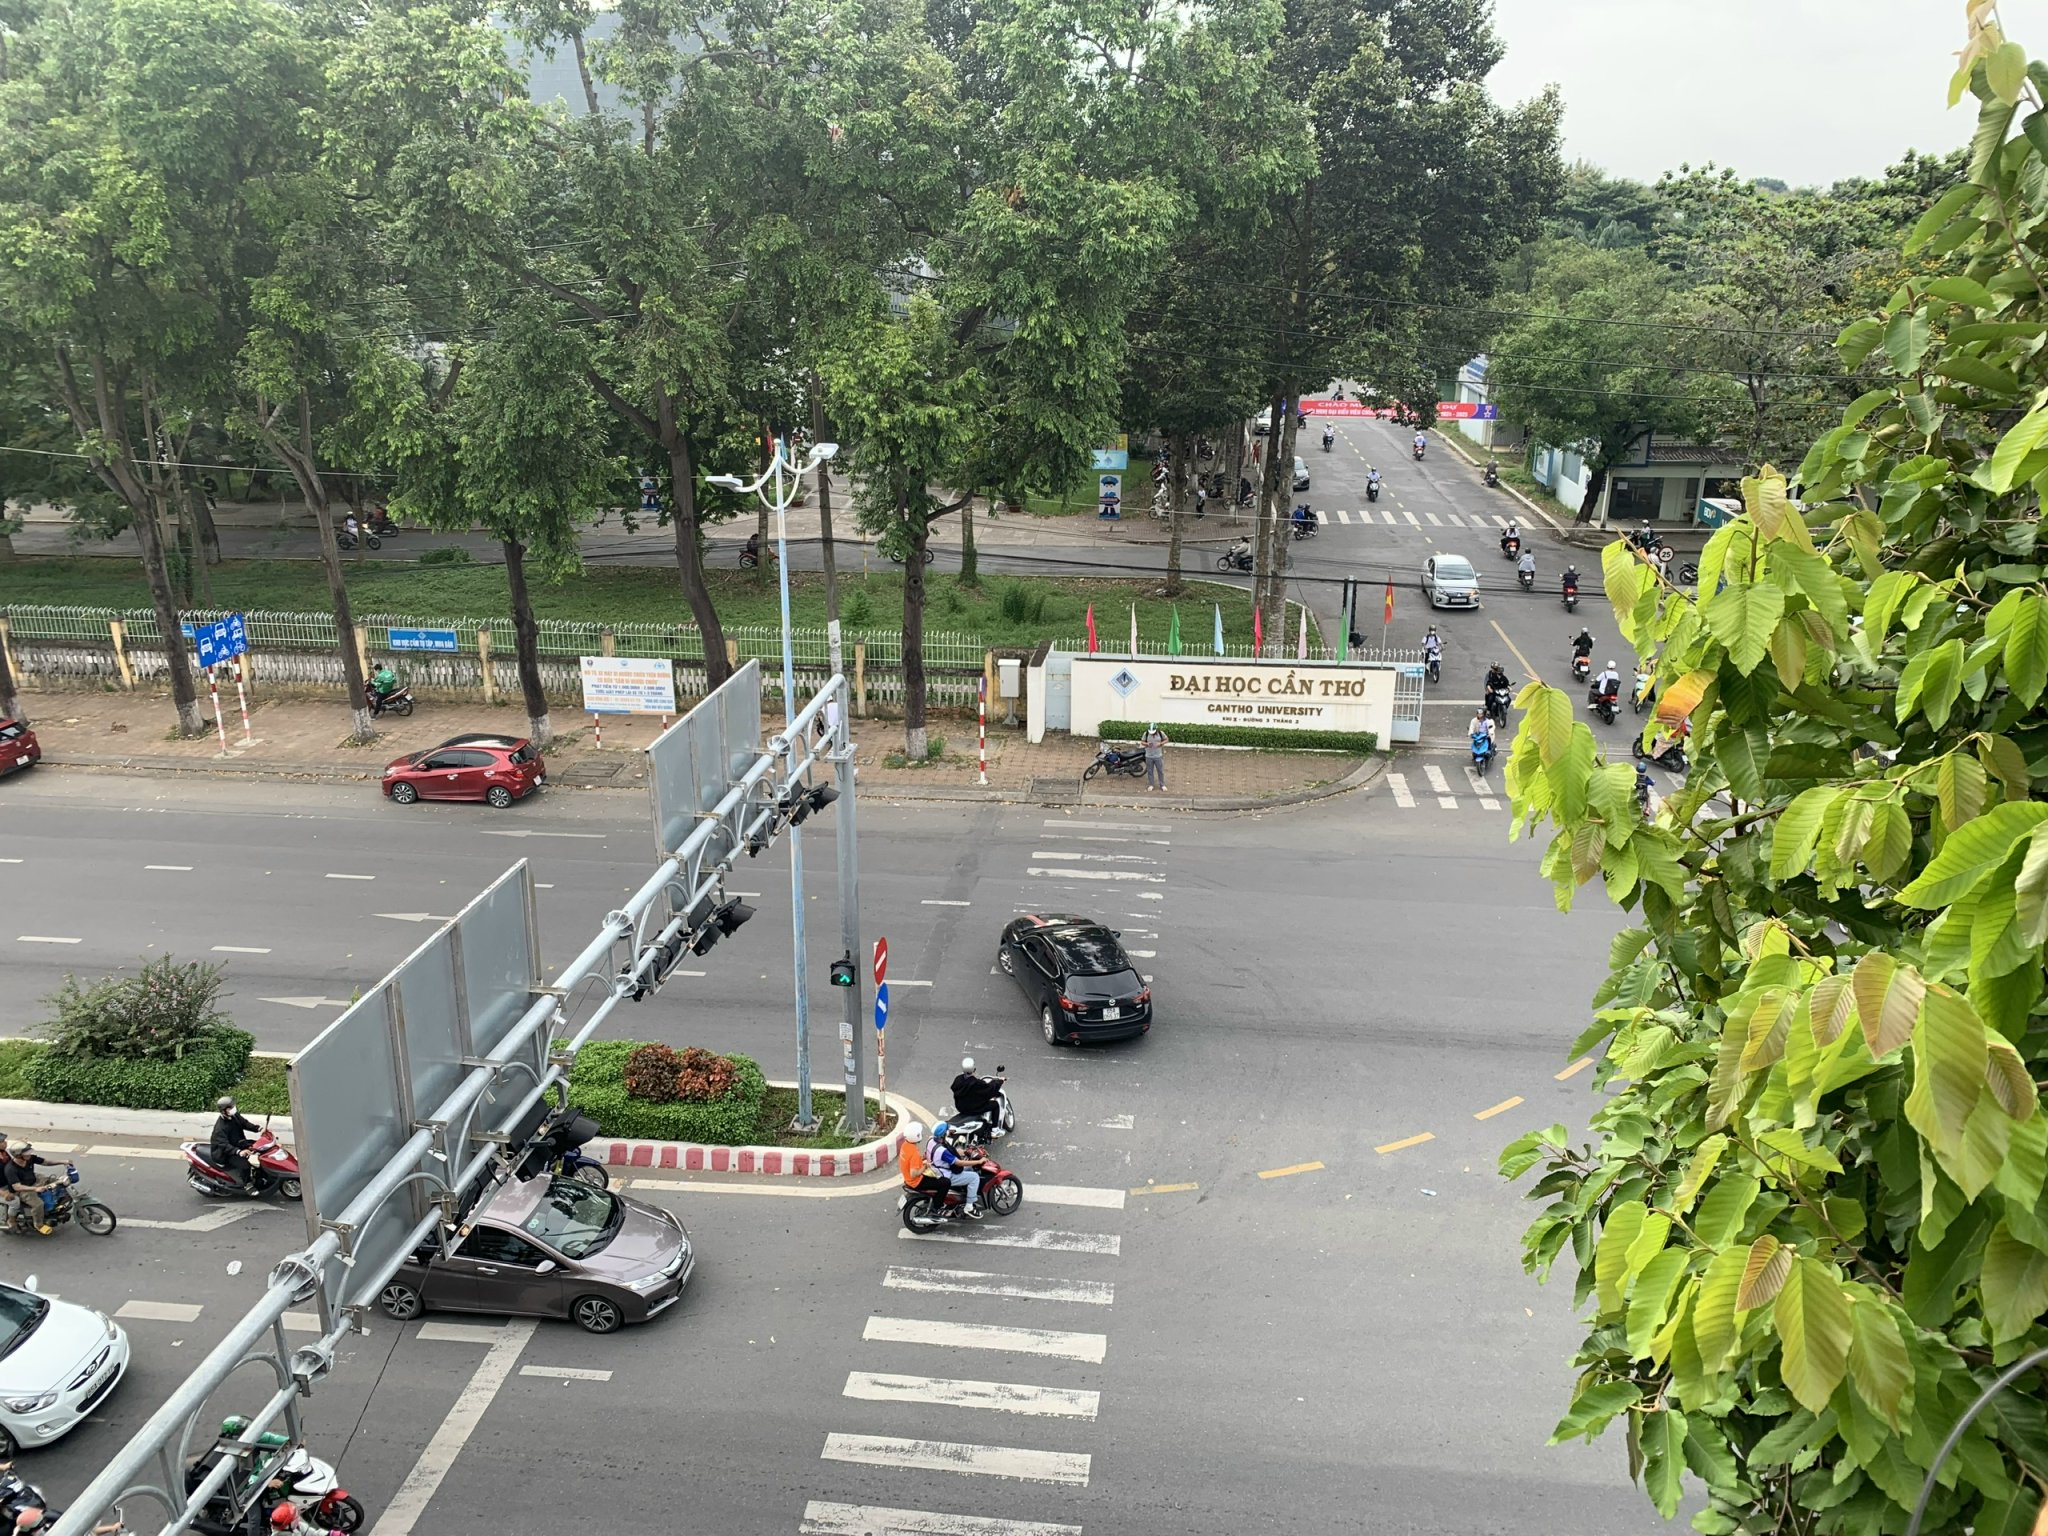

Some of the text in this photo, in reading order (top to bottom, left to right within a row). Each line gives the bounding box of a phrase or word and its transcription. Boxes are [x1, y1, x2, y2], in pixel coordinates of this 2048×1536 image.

[1170, 670, 1366, 697] ĐẠI HỌC CẦN THƠ
[1208, 704, 1323, 716] CANTHO UNIVERSITY
